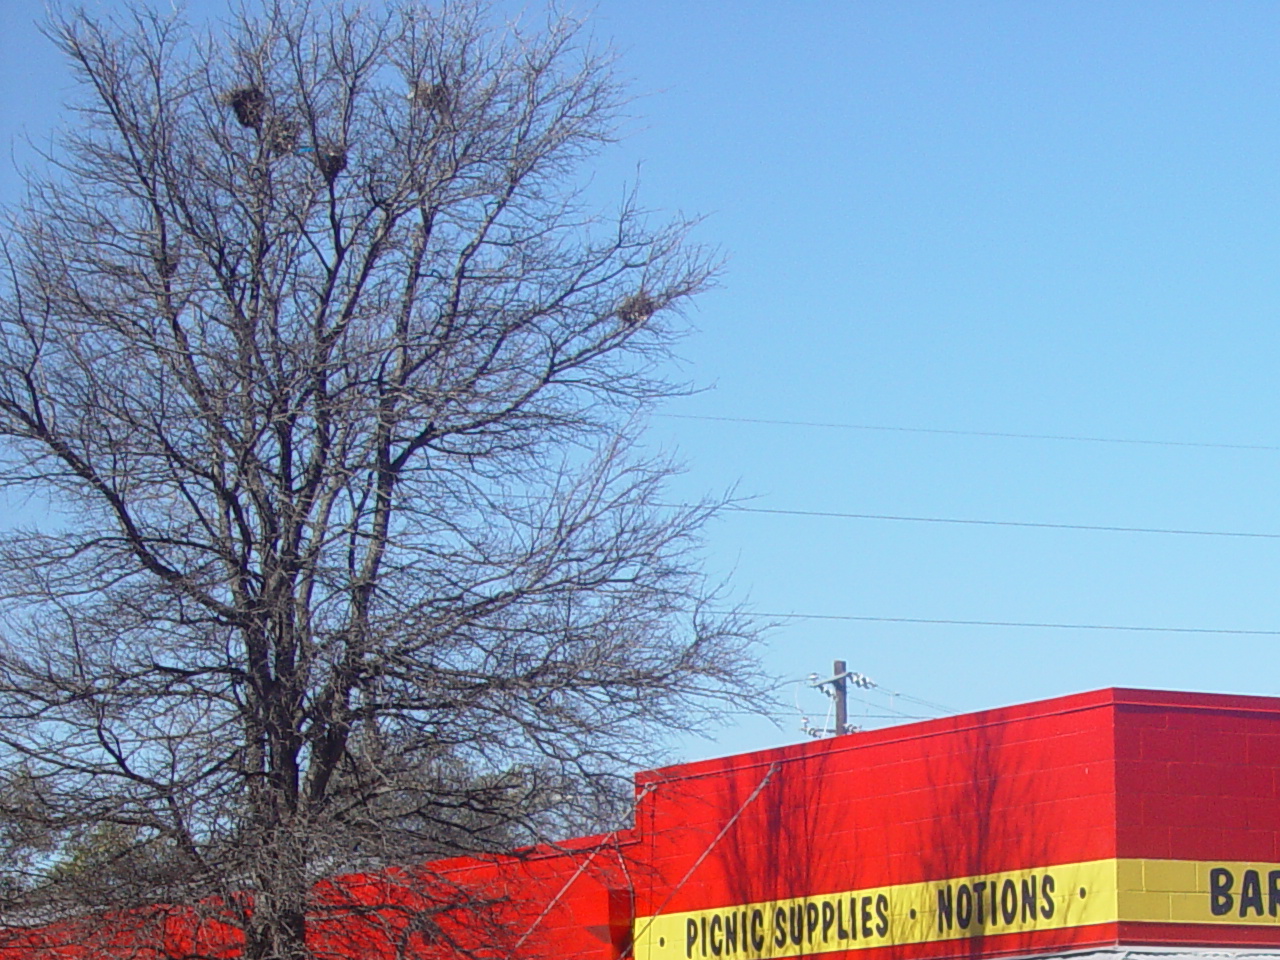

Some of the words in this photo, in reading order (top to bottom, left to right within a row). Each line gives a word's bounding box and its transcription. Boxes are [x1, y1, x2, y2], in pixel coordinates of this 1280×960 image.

[686, 907, 765, 959] PICNIC
[774, 893, 889, 949] SUPPLIES
[937, 873, 1056, 933] NOTIONS
